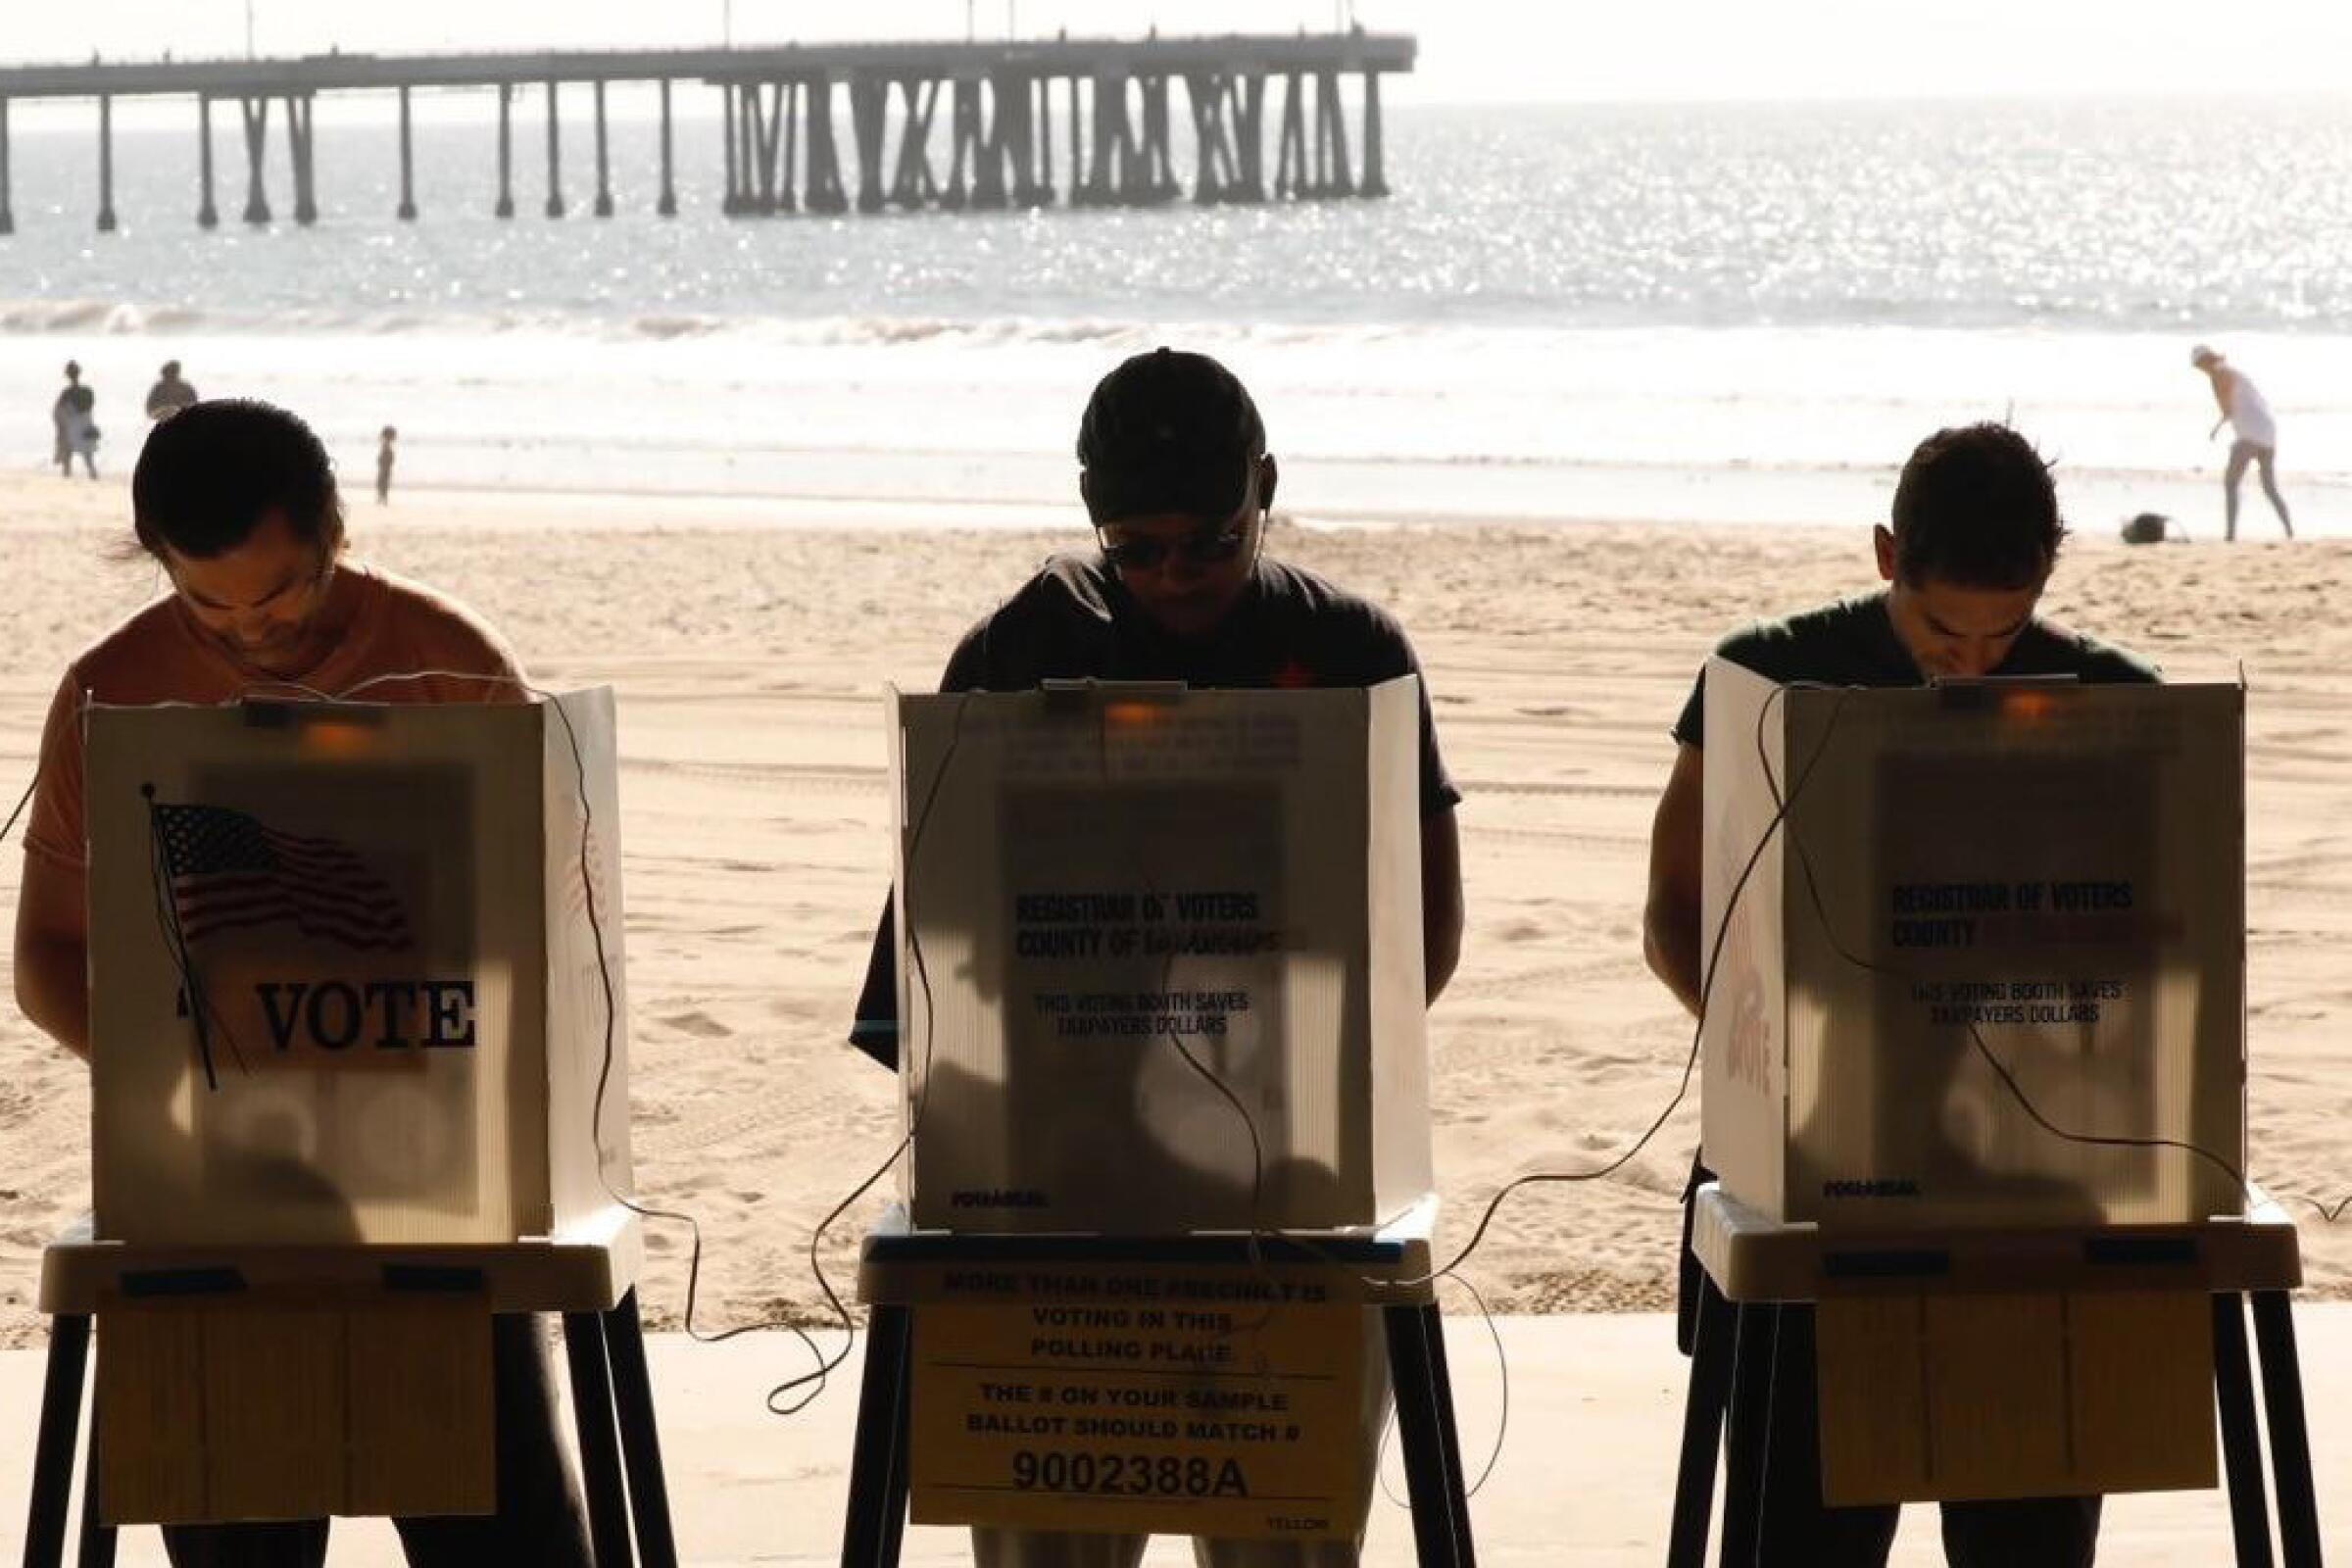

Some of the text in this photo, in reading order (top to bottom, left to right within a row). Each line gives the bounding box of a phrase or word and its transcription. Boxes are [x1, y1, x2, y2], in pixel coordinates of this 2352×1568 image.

[1176, 893, 1258, 920] VOTERS
[2016, 883, 2043, 910] OF
[2050, 881, 2132, 910] VOTERS
[1016, 929, 1102, 957] COUNTY
[1108, 929, 1140, 957] OF
[1892, 919, 1976, 948] COUNTY
[1196, 992, 1250, 1012] SAVES
[2010, 981, 2064, 1001] BOOTH
[255, 980, 475, 1050] VOTE
[2030, 1004, 2099, 1023] DOLLARS
[1028, 1274, 1098, 1297] THAN
[1105, 1276, 1160, 1298] ONE
[1032, 1307, 1232, 1332] VOTING IN THIS
[1031, 1340, 1143, 1361] POLLING
[980, 1383, 1289, 1411] THE # ON YOUR SAMPLE
[965, 1413, 1067, 1435] BALLOT
[1073, 1417, 1179, 1439] SHOULD
[1187, 1420, 1277, 1442] MATCH
[1012, 1450, 1250, 1497] 9002388A
